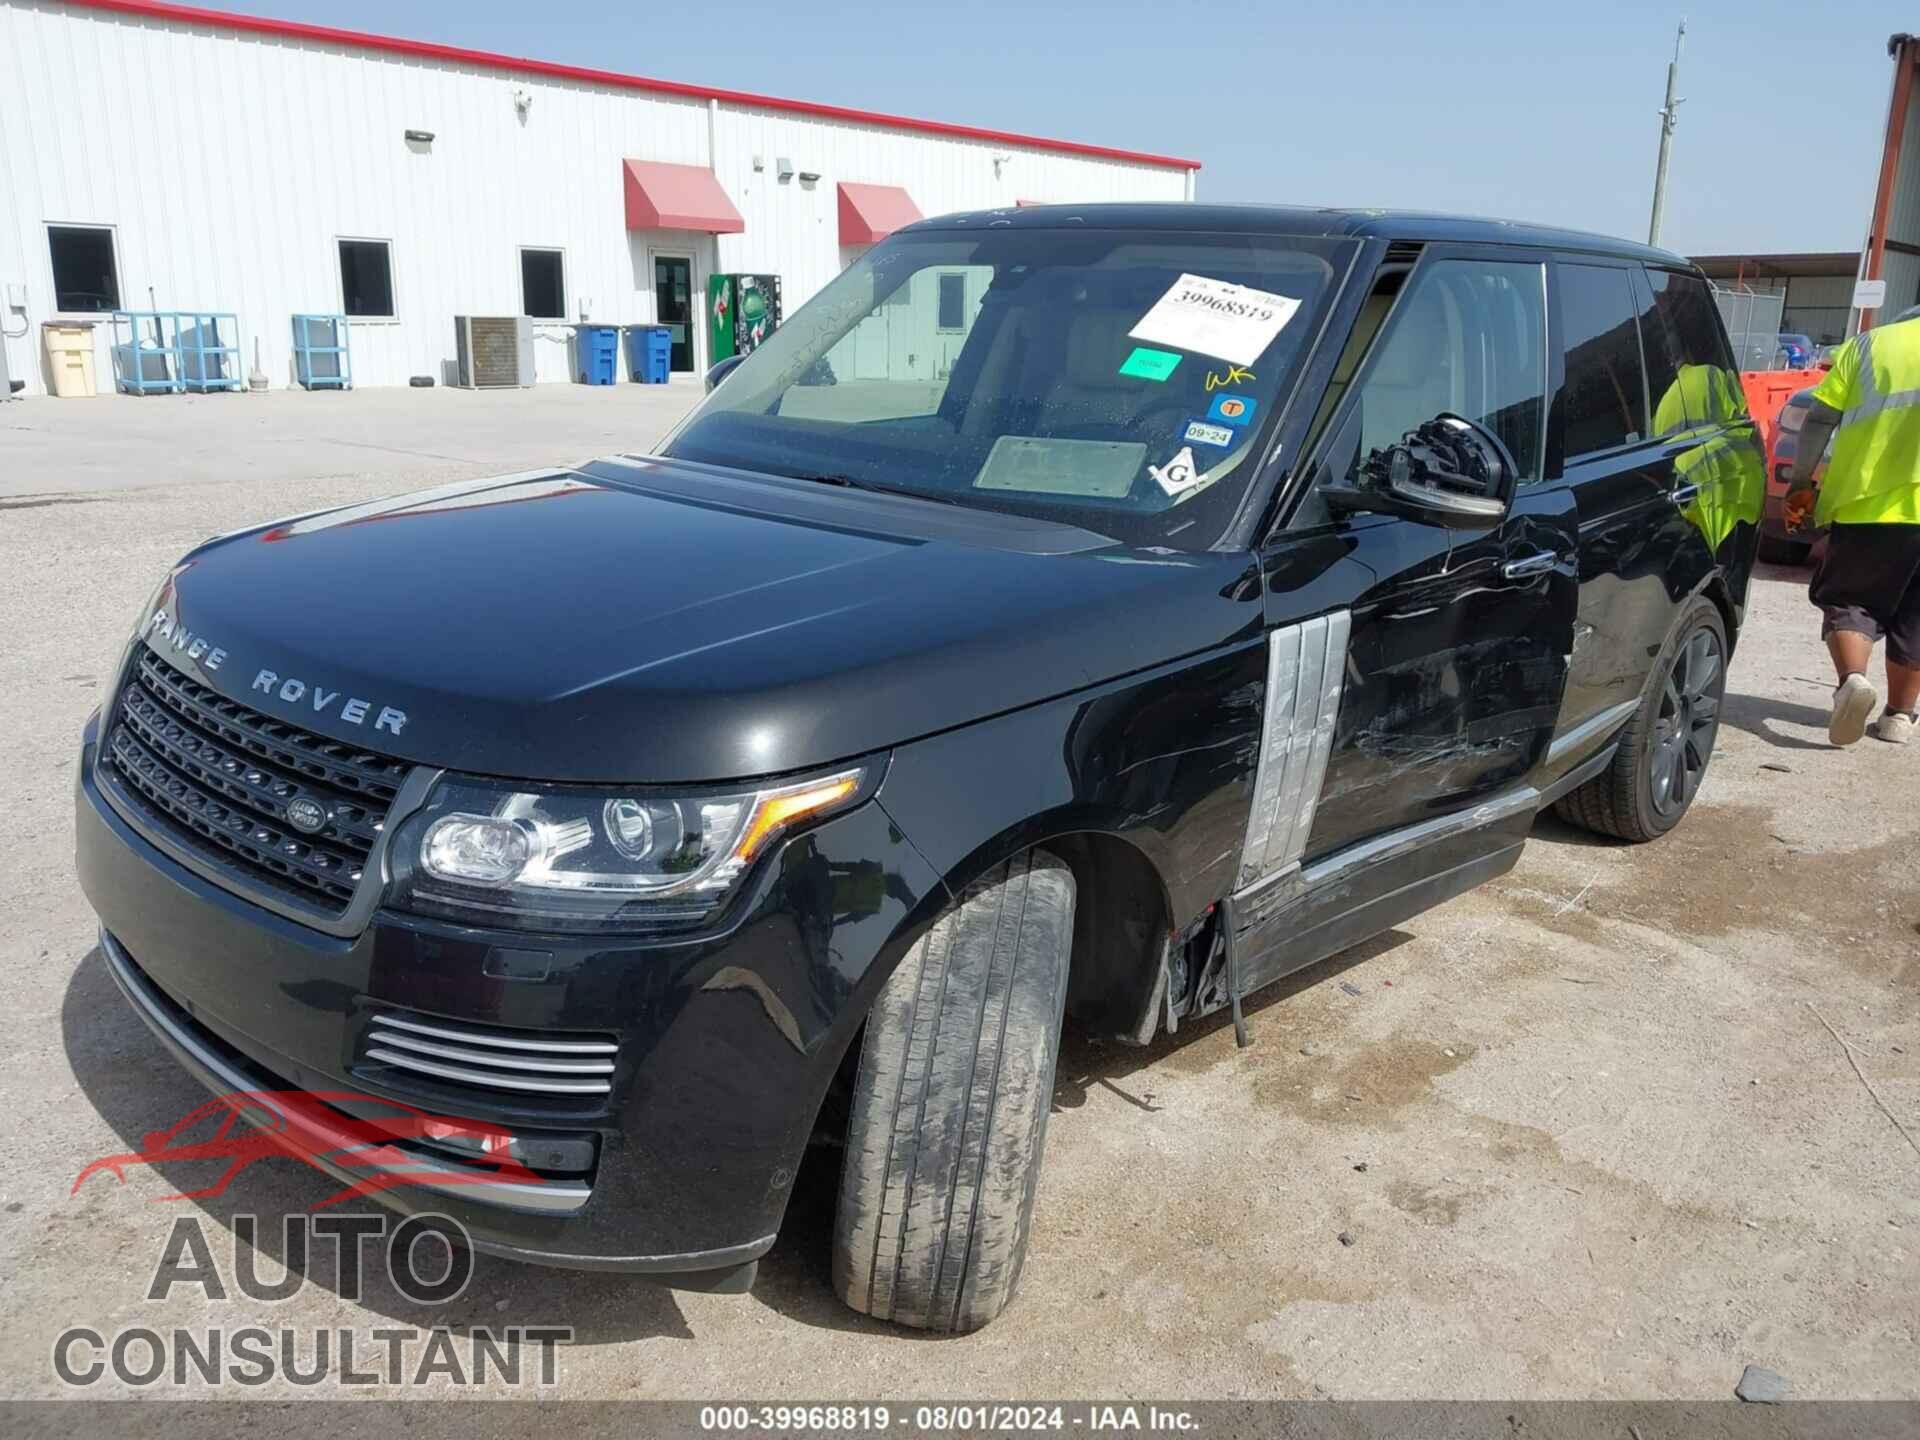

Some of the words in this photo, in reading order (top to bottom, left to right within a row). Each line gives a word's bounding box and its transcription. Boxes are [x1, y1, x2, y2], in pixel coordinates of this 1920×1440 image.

[1175, 291, 1273, 320] 39968819
[1224, 402, 1241, 417] T
[1188, 427, 1227, 443] 09-24
[1167, 465, 1188, 482] G
[152, 609, 228, 670] RANGE
[252, 669, 407, 735] ROVER
